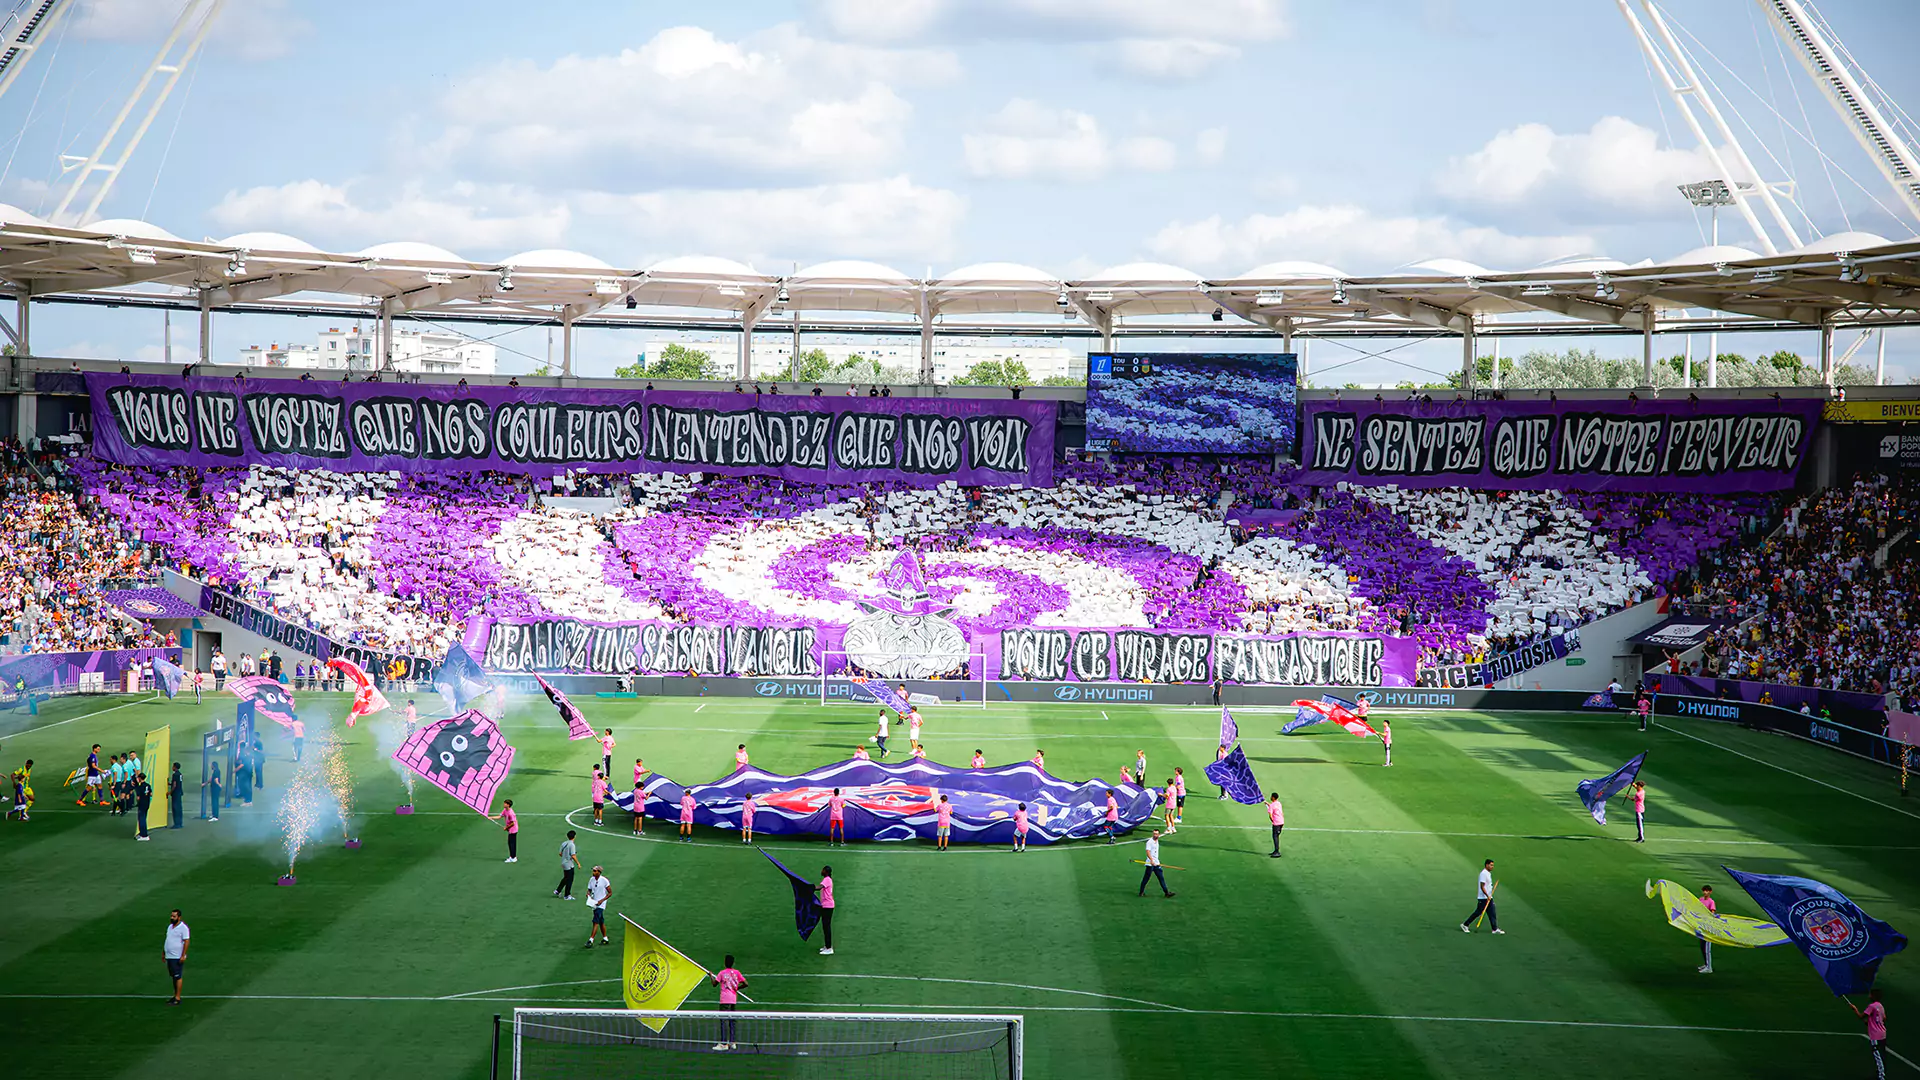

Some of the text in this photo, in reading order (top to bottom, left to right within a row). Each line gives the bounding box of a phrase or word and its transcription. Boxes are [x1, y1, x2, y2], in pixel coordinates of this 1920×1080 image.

[112, 388, 188, 444] VOUS
[196, 391, 238, 449] NE
[247, 397, 347, 453] VOYEZ
[353, 402, 415, 453] QUE
[421, 402, 486, 455] NOS
[650, 407, 831, 465] N'ENTENDEZ
[838, 414, 896, 468] QUE
[905, 418, 961, 470] NOS
[1313, 414, 1801, 474] NE SENTEZ QUE NOTRE FERVEUR
[1901, 435, 1920, 443] BAN
[210, 590, 319, 658] PER TOLOSA
[592, 626, 640, 673] UNE
[641, 625, 720, 674] SAISON
[1001, 631, 1382, 685] POUR CE VIRAGE FANTASTIQUE
[1489, 639, 1556, 682] TOLOSA
[1085, 688, 1154, 701] HYUNDAI
[1386, 693, 1455, 705] HYUNDAI
[1689, 702, 1739, 719] HYUNDAI
[1811, 944, 1856, 957] FOOTBALL
